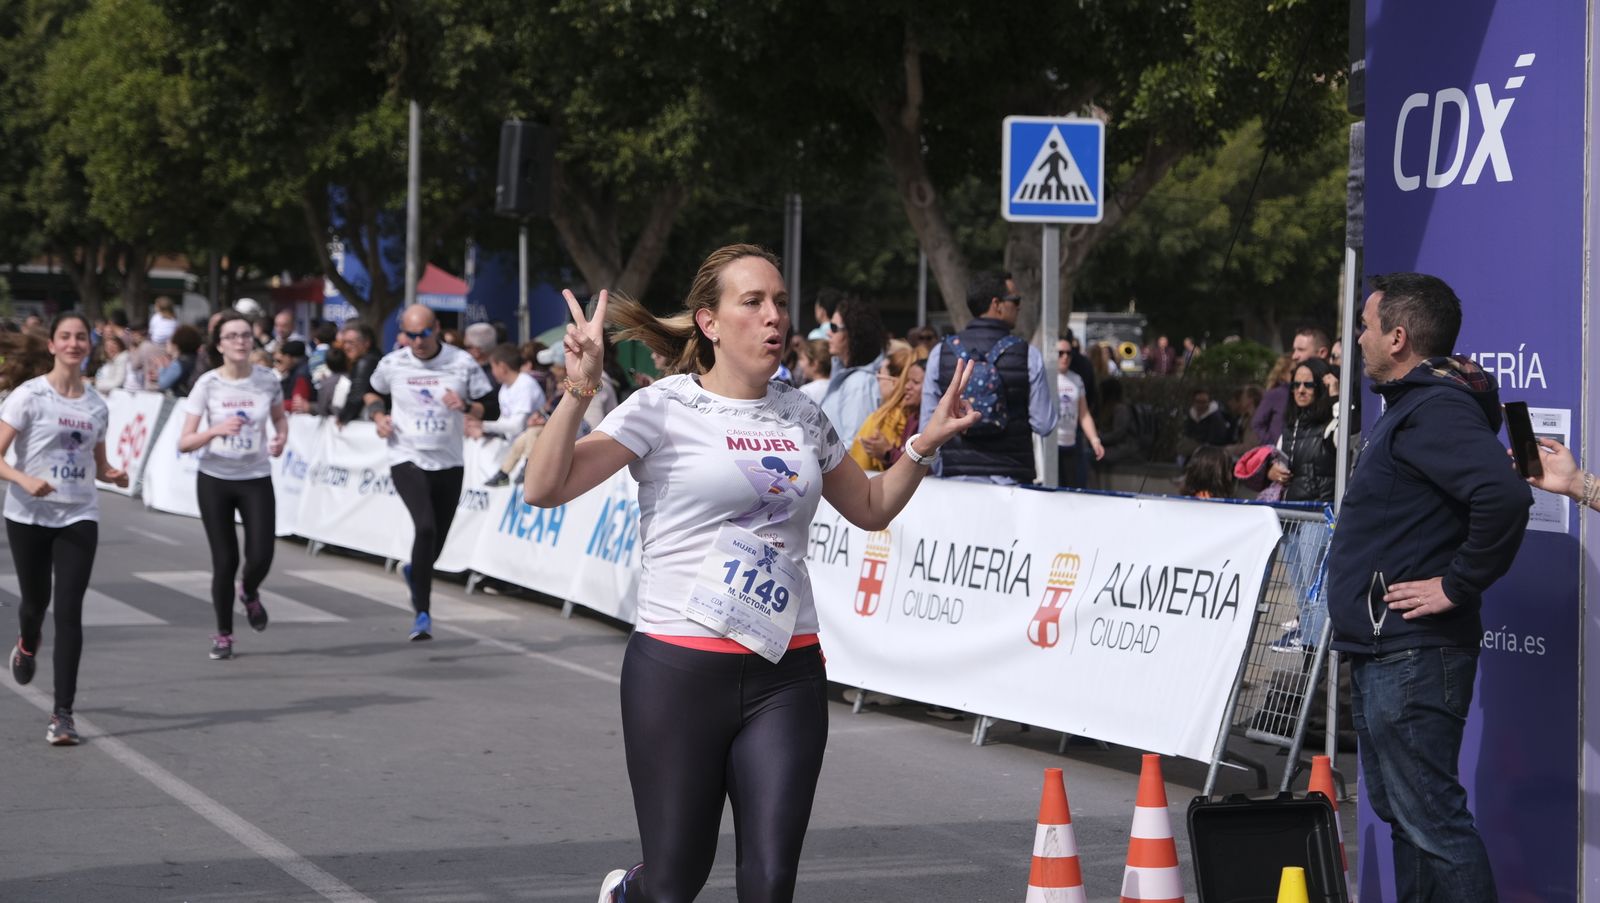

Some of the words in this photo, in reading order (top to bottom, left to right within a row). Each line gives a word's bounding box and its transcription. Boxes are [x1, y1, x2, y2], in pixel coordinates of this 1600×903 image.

[1393, 53, 1536, 192] CDX
[58, 417, 94, 432] MUJER
[726, 429, 762, 437] CARRERA
[765, 430, 775, 438] DE
[725, 435, 800, 452] MUJER
[50, 464, 86, 480] 1044
[732, 540, 757, 556] MUJER
[909, 538, 1032, 597] ALMERÍA
[722, 559, 790, 614] 1149
[727, 586, 737, 598] M.
[739, 591, 772, 617] VICTORIA
[1093, 559, 1241, 622] ALMERÍA
[902, 589, 964, 625] CIUDAD
[1090, 617, 1161, 654] CIUDAD
[1479, 625, 1547, 656] ería.es
